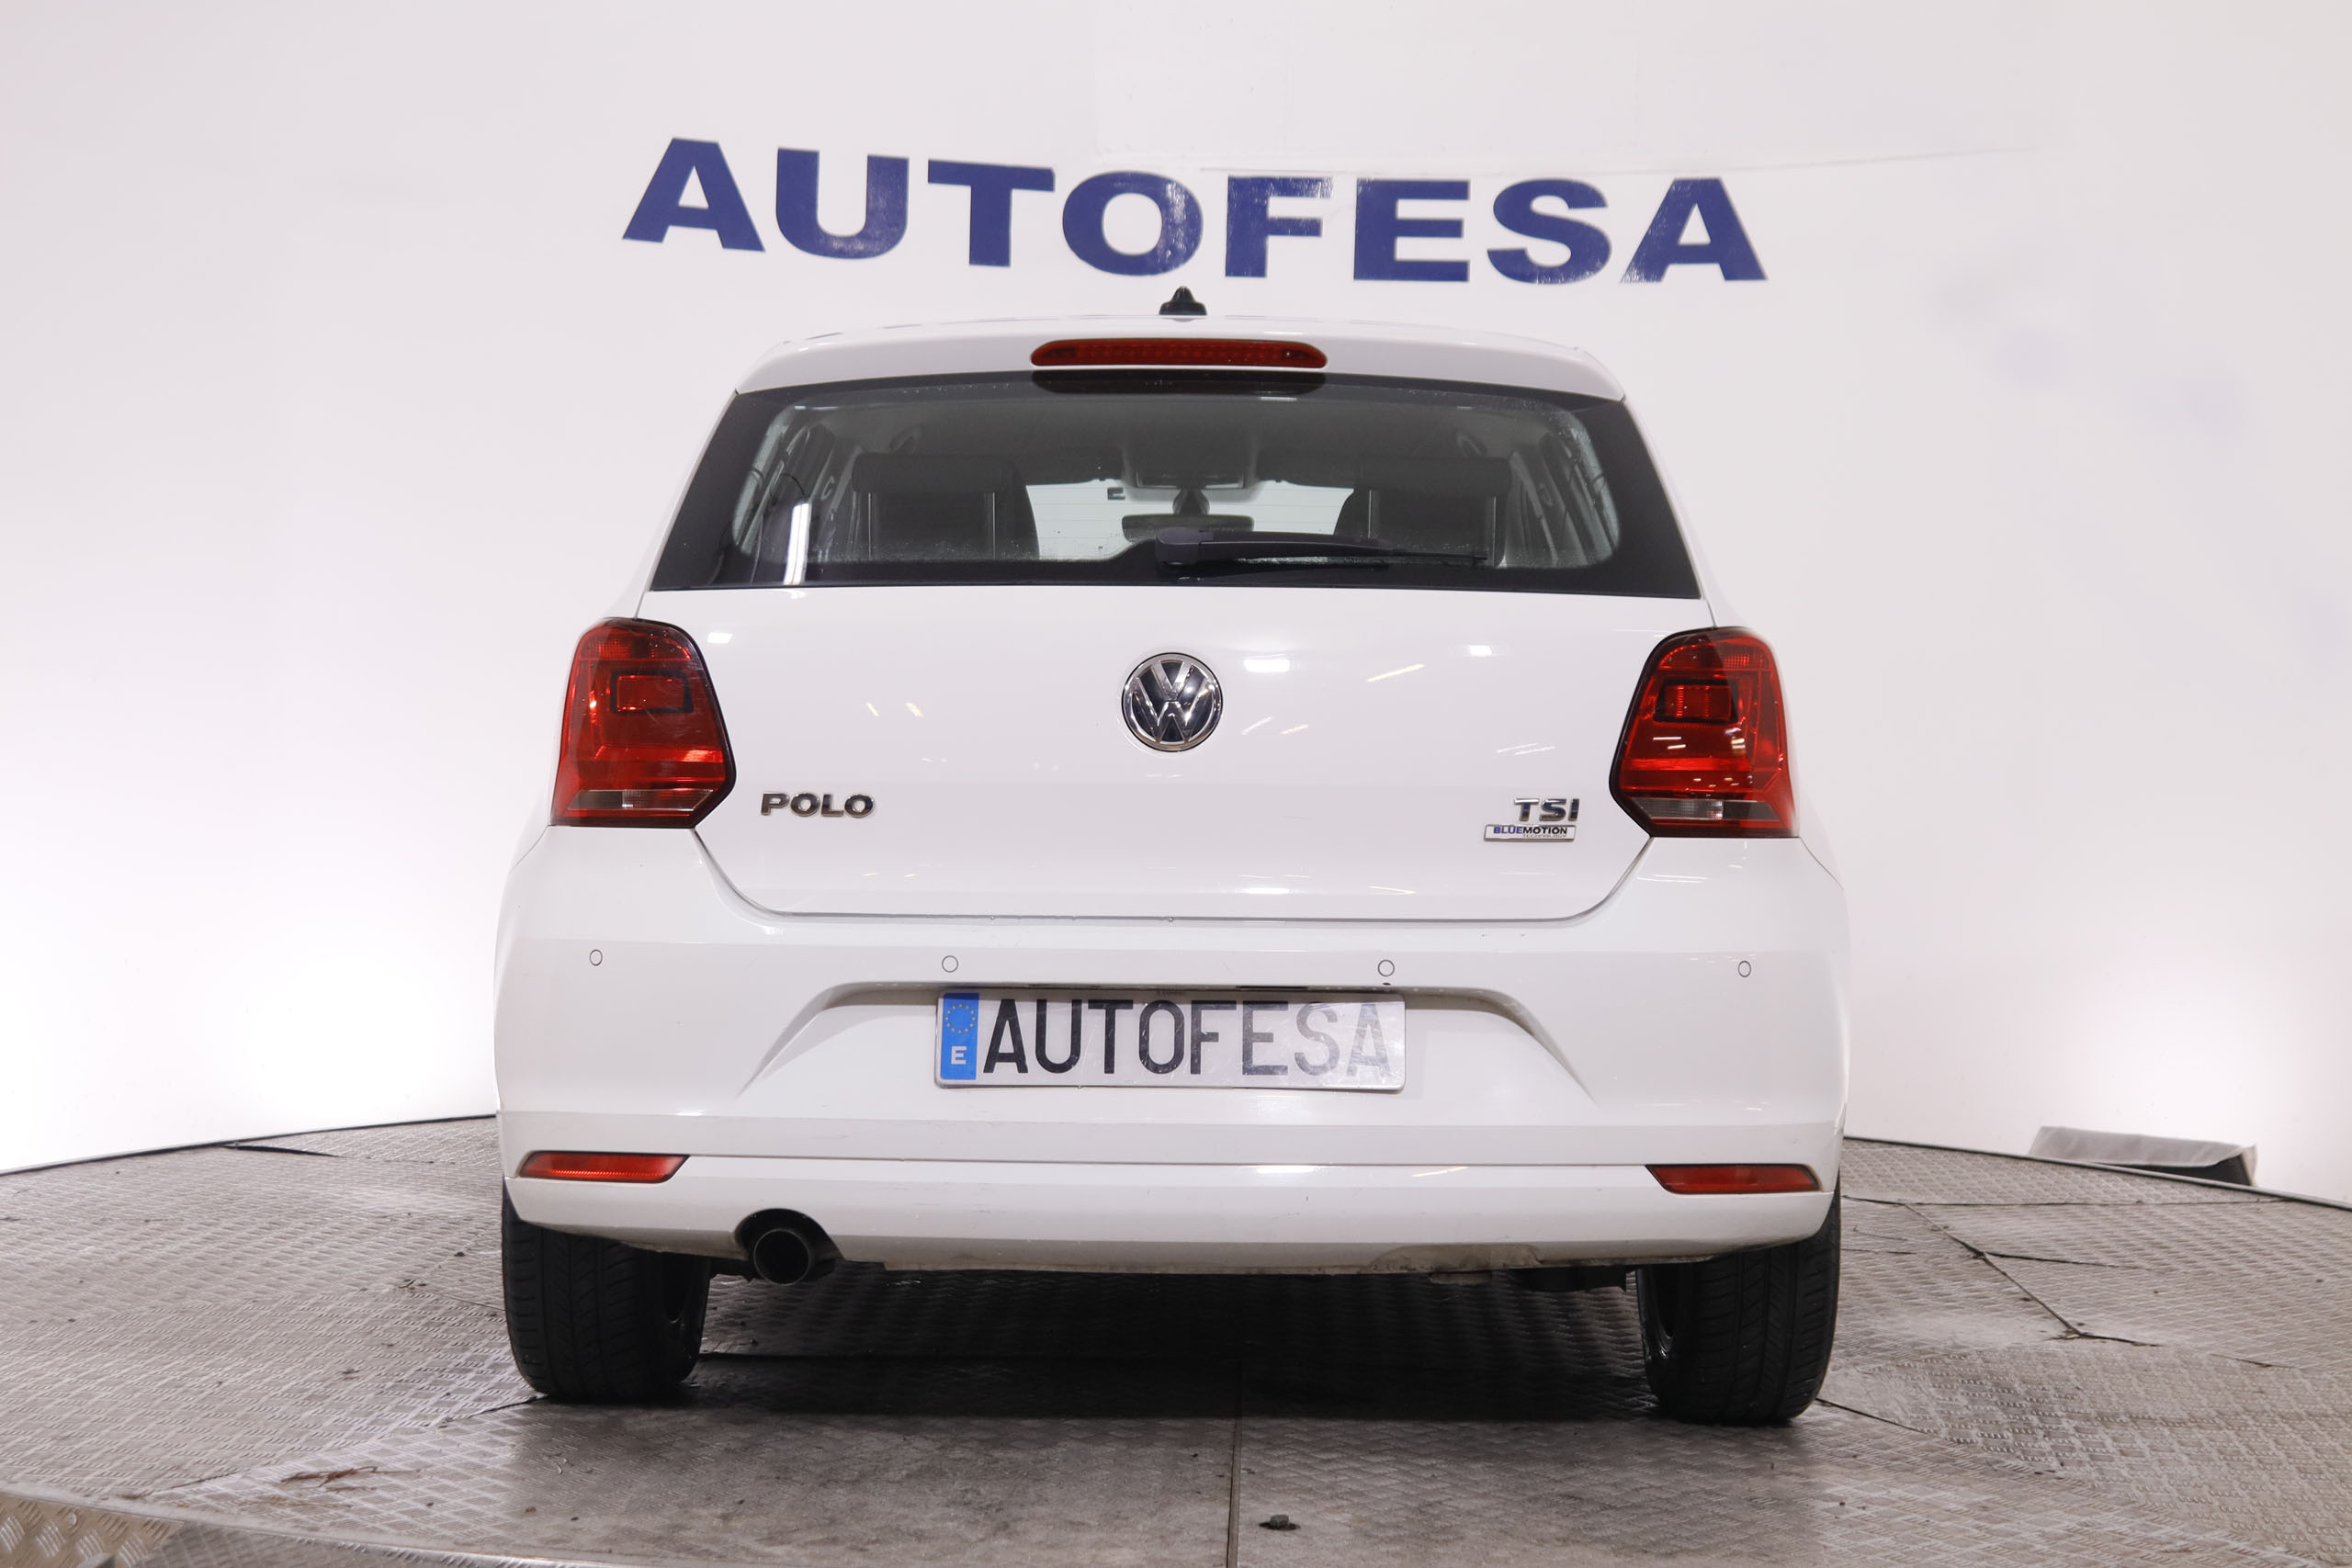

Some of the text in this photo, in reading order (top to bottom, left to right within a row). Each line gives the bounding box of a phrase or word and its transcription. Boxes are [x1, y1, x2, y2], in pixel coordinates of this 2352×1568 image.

[622, 137, 1767, 285] AUTOFESA
[761, 792, 875, 818] POLO
[1514, 797, 1580, 822] TSI
[1493, 826, 1567, 835] BLUEMOTION
[983, 998, 1390, 1077] AUTOFESA
[950, 1045, 967, 1065] E
